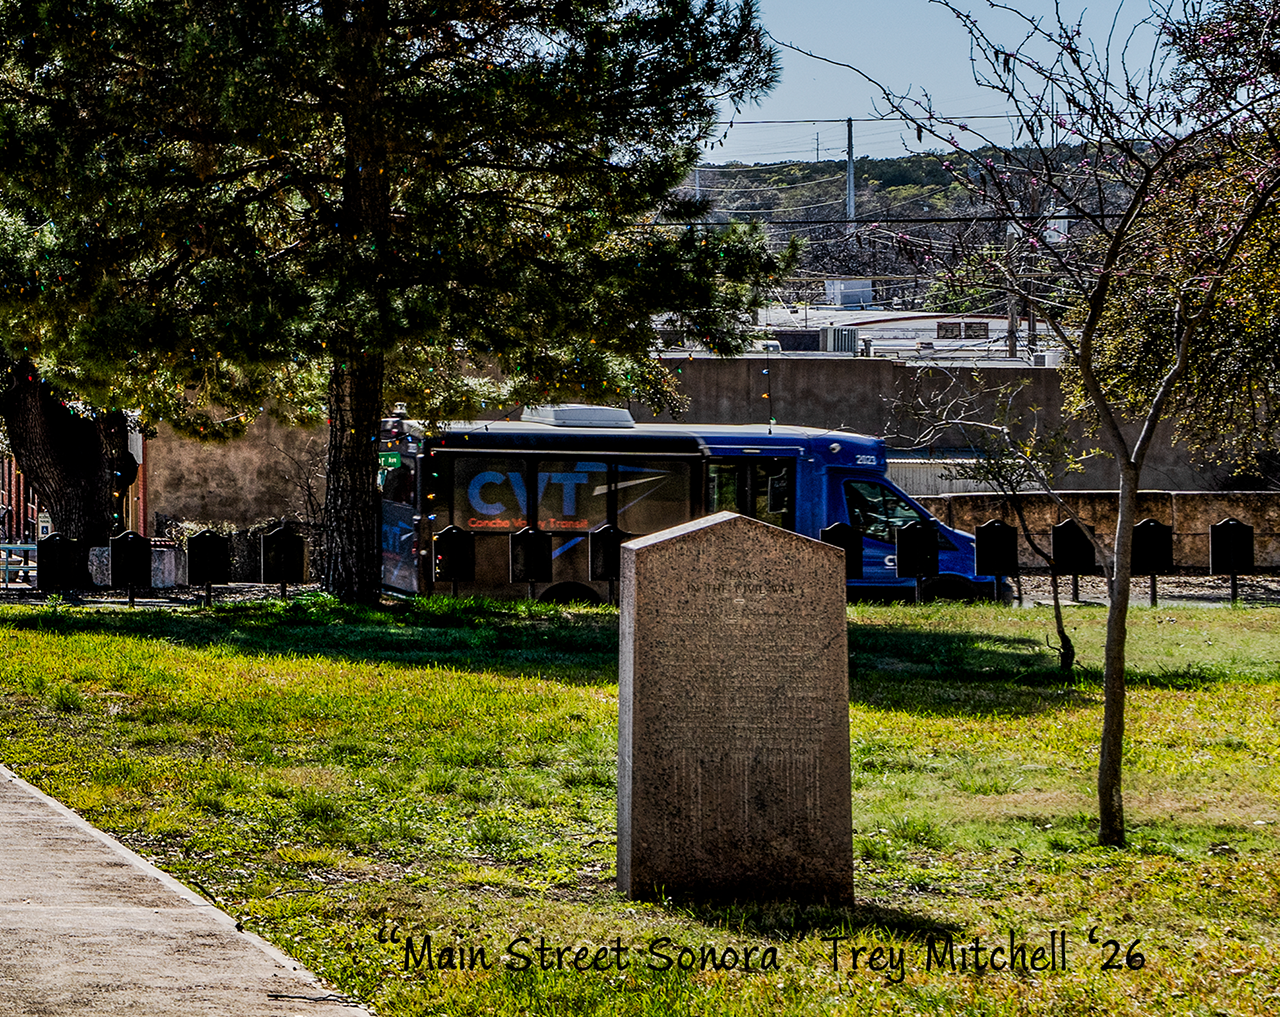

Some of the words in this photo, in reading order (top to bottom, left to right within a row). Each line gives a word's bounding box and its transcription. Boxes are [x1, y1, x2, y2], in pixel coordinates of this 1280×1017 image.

[467, 470, 589, 516] CVT
[468, 517, 510, 528] Concha
[549, 517, 589, 529] Transit
[686, 584, 700, 594] IN
[706, 584, 728, 594] THE
[734, 584, 765, 594] CIVIL
[770, 584, 795, 594] WAR
